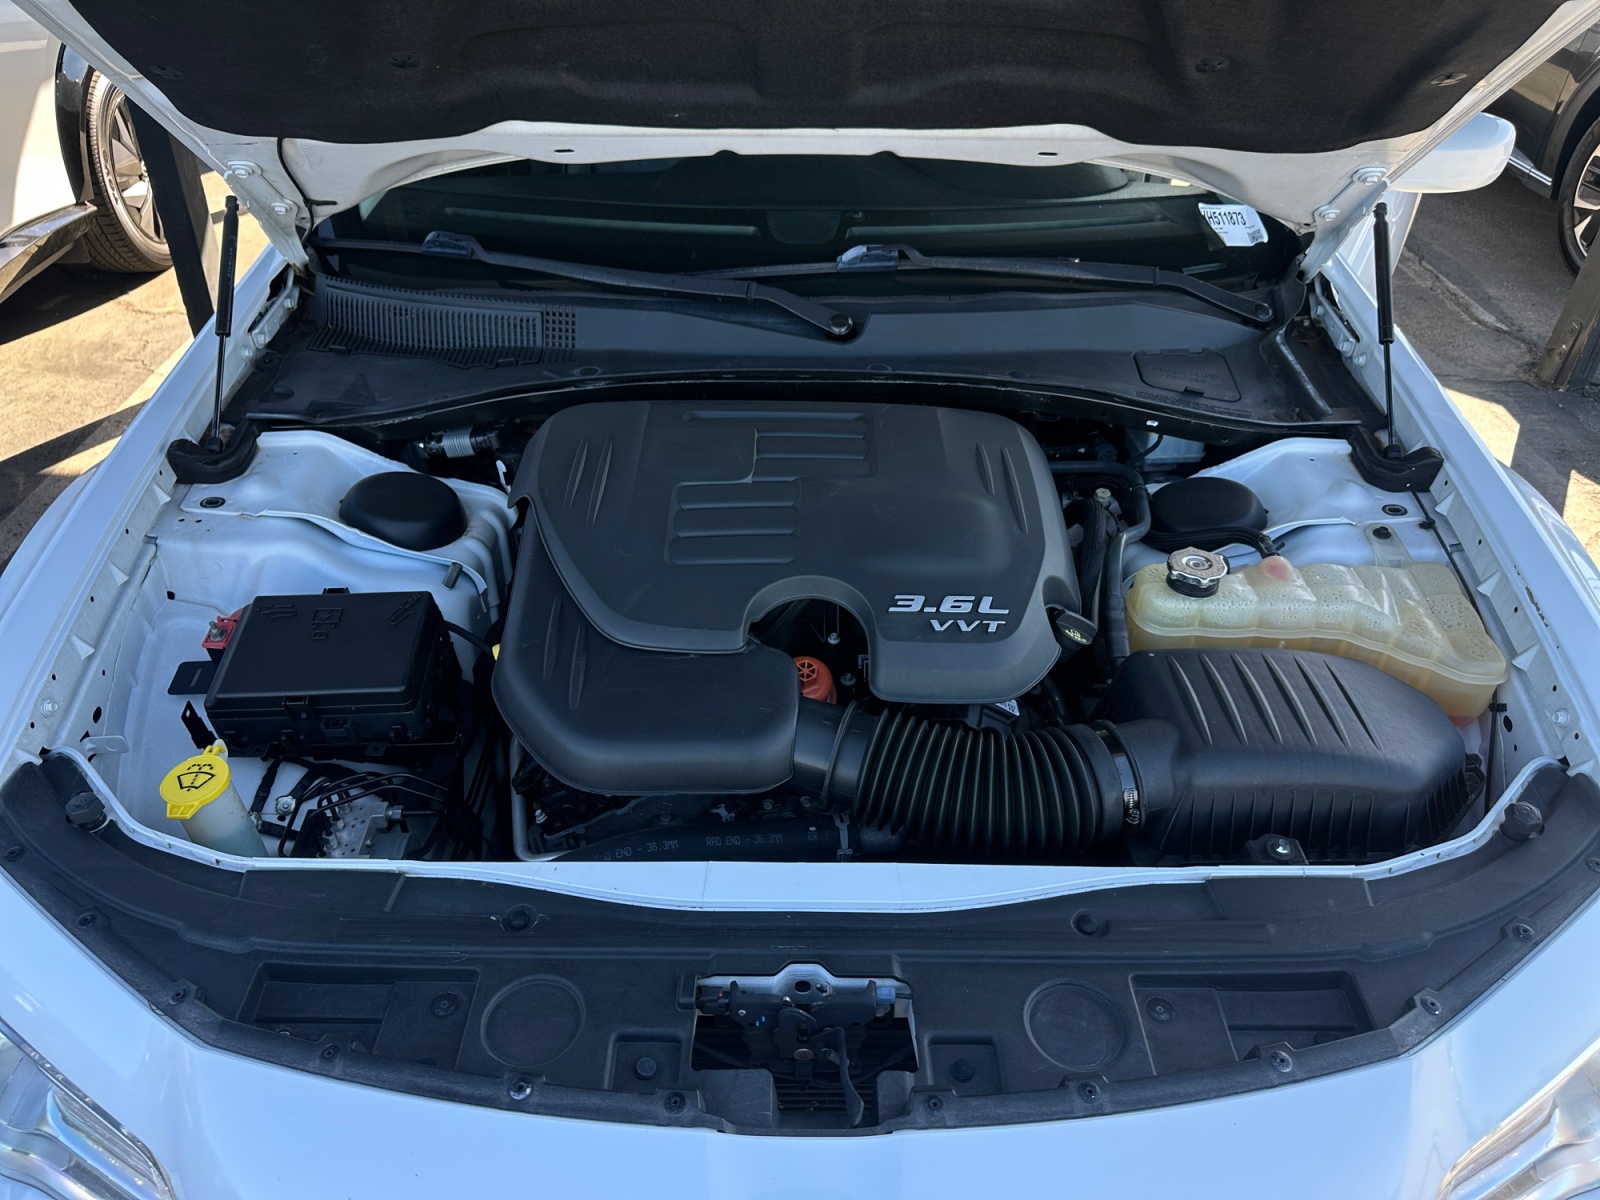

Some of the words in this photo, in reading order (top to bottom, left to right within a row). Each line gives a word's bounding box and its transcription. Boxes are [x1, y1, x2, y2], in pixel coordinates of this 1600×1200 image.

[888, 594, 1010, 614] 3.6L
[930, 619, 1006, 632] VVT
[705, 836, 721, 846] RAD
[725, 835, 741, 846] END
[754, 833, 783, 845] 36.3MM
[615, 846, 632, 859] END
[646, 840, 679, 853] 36.3MM
